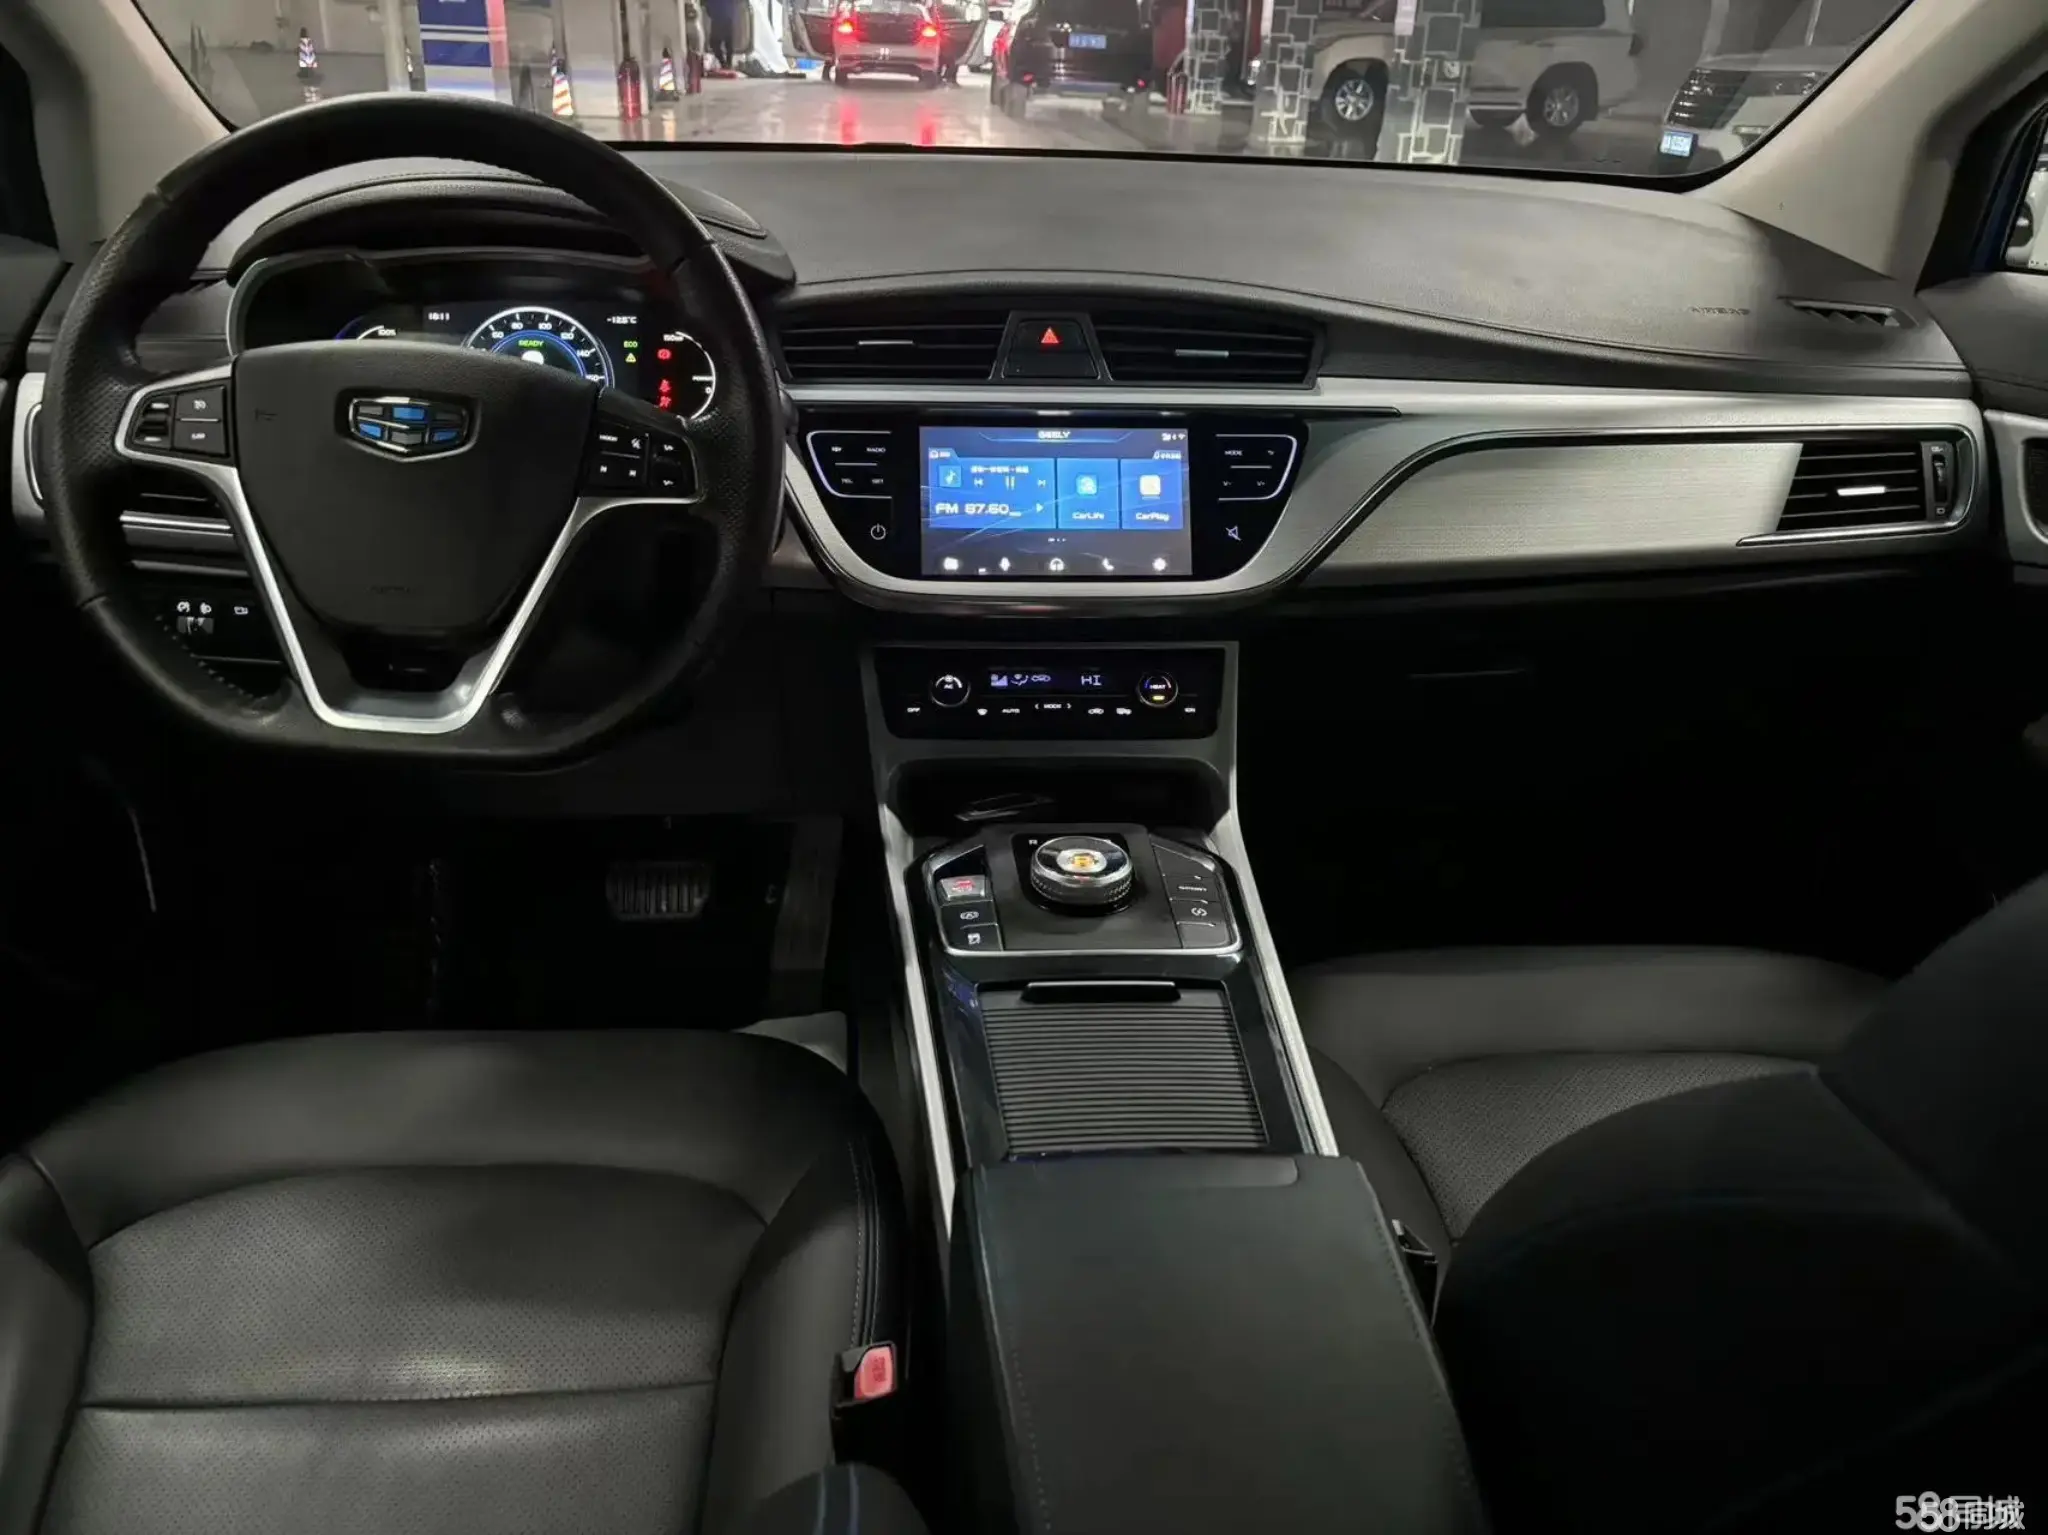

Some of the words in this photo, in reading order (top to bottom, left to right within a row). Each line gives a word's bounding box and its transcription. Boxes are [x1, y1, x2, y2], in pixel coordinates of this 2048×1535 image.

[538, 321, 552, 330] 100
[518, 339, 544, 347] READY
[623, 340, 638, 348] ECO
[935, 502, 959, 514] FM
[1135, 511, 1170, 522] CarPlay
[1080, 675, 1102, 686] HI
